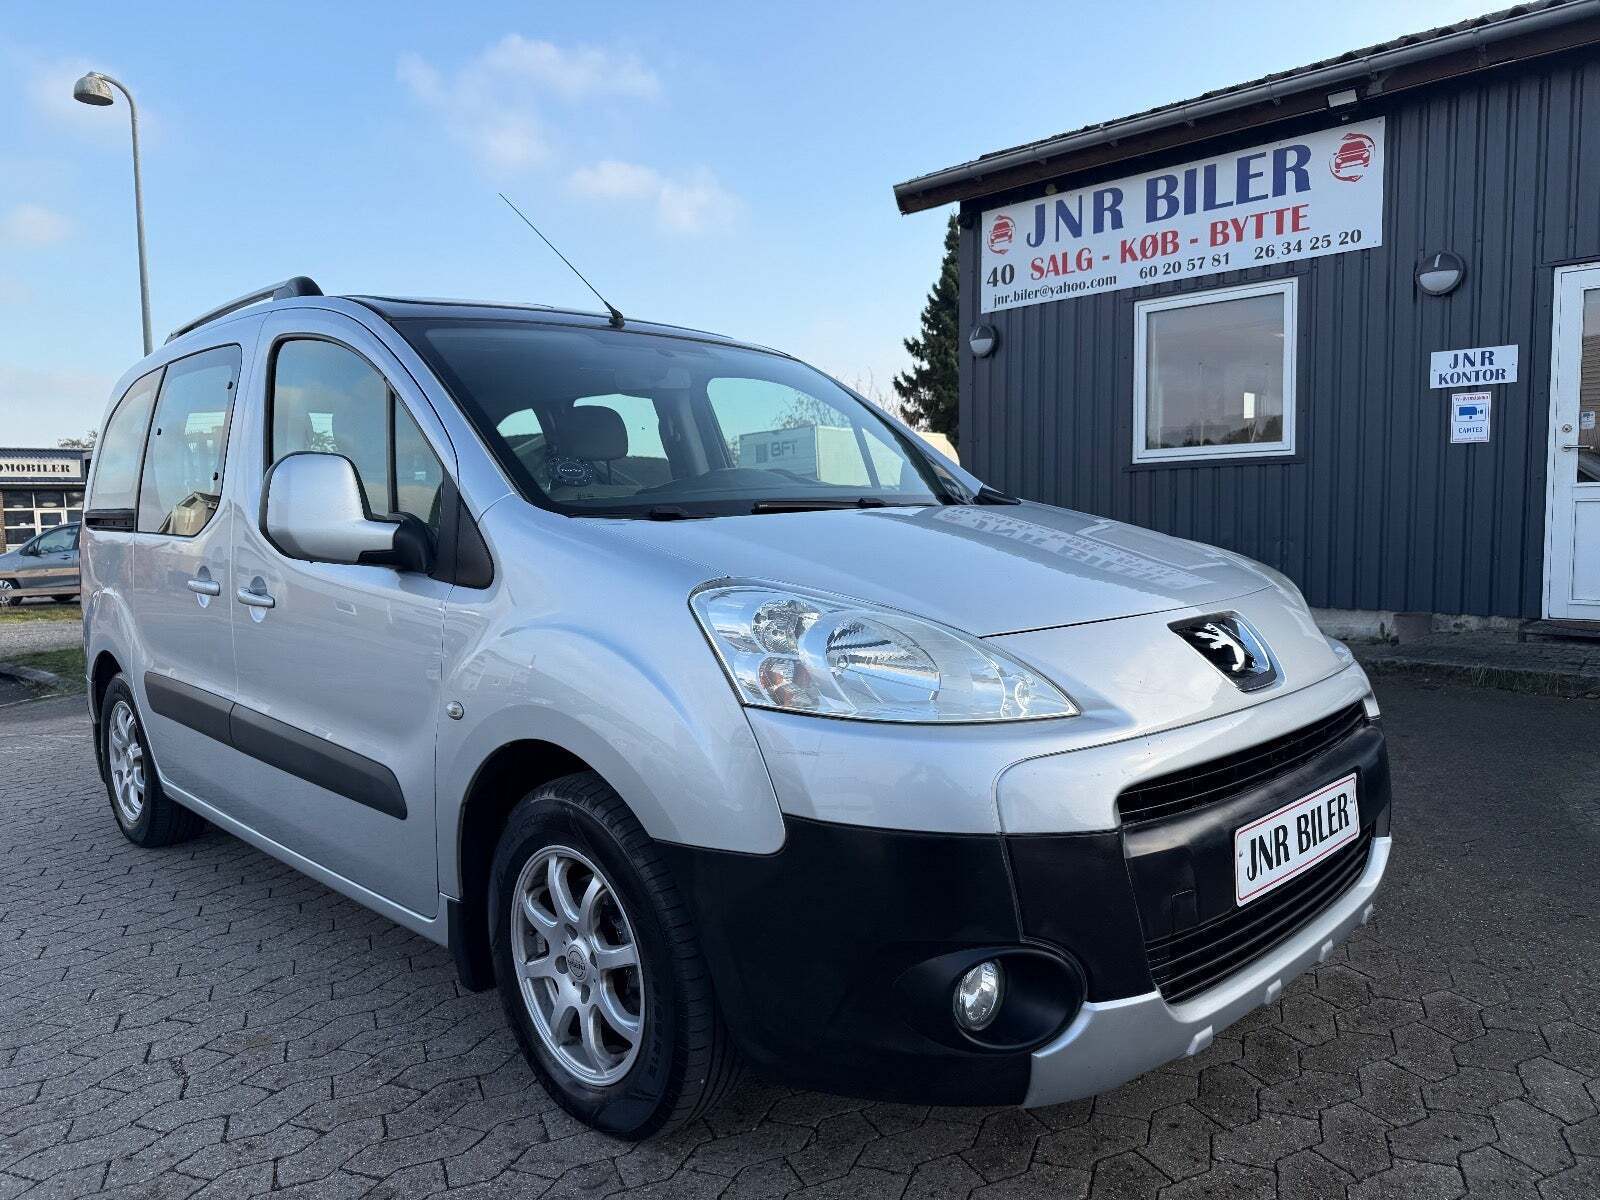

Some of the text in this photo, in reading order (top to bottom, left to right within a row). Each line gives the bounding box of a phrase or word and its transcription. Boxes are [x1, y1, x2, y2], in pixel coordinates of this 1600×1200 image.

[1026, 144, 1312, 248] JNR BILER
[1030, 247, 1093, 281] SALG
[1120, 230, 1180, 265] KØB
[1209, 203, 1310, 248] BYTTE
[1139, 265, 1158, 279] 60
[1162, 261, 1181, 276] 20
[1186, 256, 1206, 272] 57
[1211, 252, 1230, 267] 81
[1254, 244, 1275, 260] 26
[1281, 239, 1302, 255] 34
[1309, 234, 1331, 251] 25
[1338, 228, 1362, 246] 20
[986, 263, 1015, 288] 40
[1438, 368, 1507, 385] KONTOR
[1449, 350, 1495, 369] JNR
[1246, 792, 1350, 882] JNR BILER
